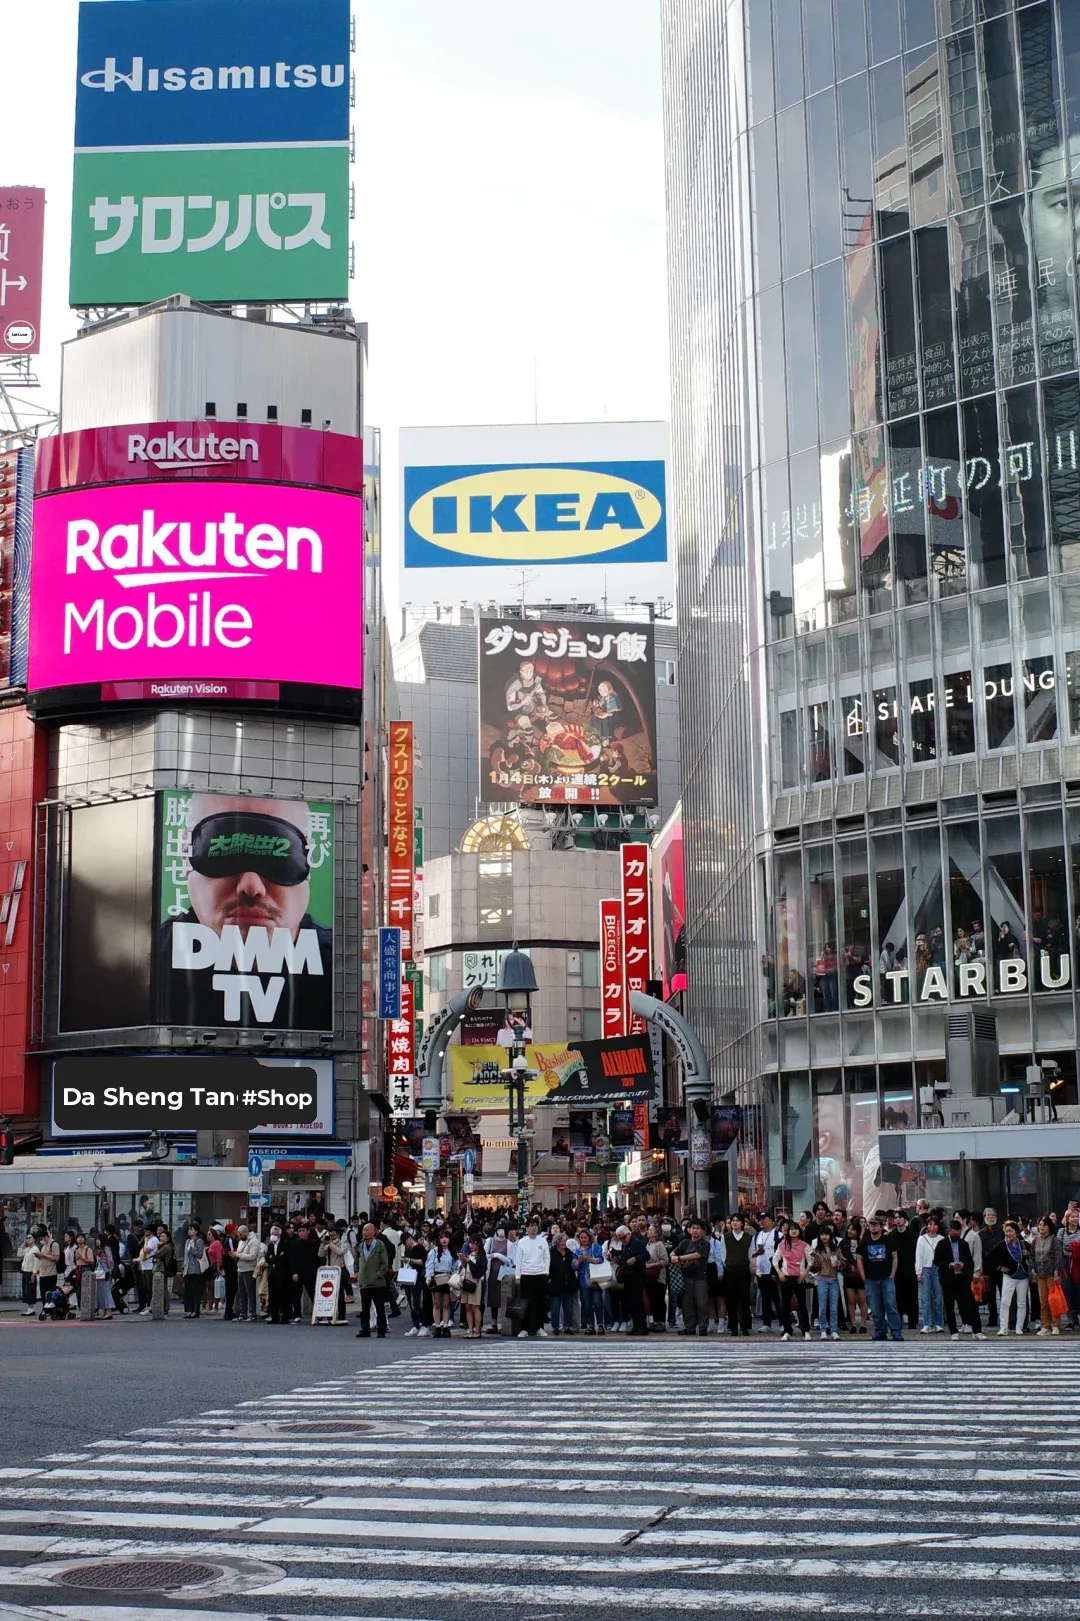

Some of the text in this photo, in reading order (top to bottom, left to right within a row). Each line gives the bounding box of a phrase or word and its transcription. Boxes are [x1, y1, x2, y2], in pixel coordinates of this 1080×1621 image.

[81, 57, 345, 92] Hisamitsu
[89, 192, 331, 255] サロンパス
[127, 431, 259, 464] Rakuten
[432, 491, 645, 534] IKEA
[66, 509, 323, 575] Rakuten
[63, 591, 252, 654] Mobile
[484, 625, 648, 664] ダンジョン飯
[151, 684, 227, 695] Rakuten Vision
[393, 727, 410, 857] クスリのことなら
[165, 796, 194, 917] 脱出せよ
[208, 832, 292, 857] 大脱出2
[305, 811, 331, 868] 再び
[625, 859, 647, 965] カラオケ
[172, 922, 324, 975] DMM
[383, 932, 397, 1015] 大盛堂商事ビル
[213, 975, 285, 1023] TV
[853, 953, 1070, 1007] STARBU
[605, 982, 622, 1038] カラ
